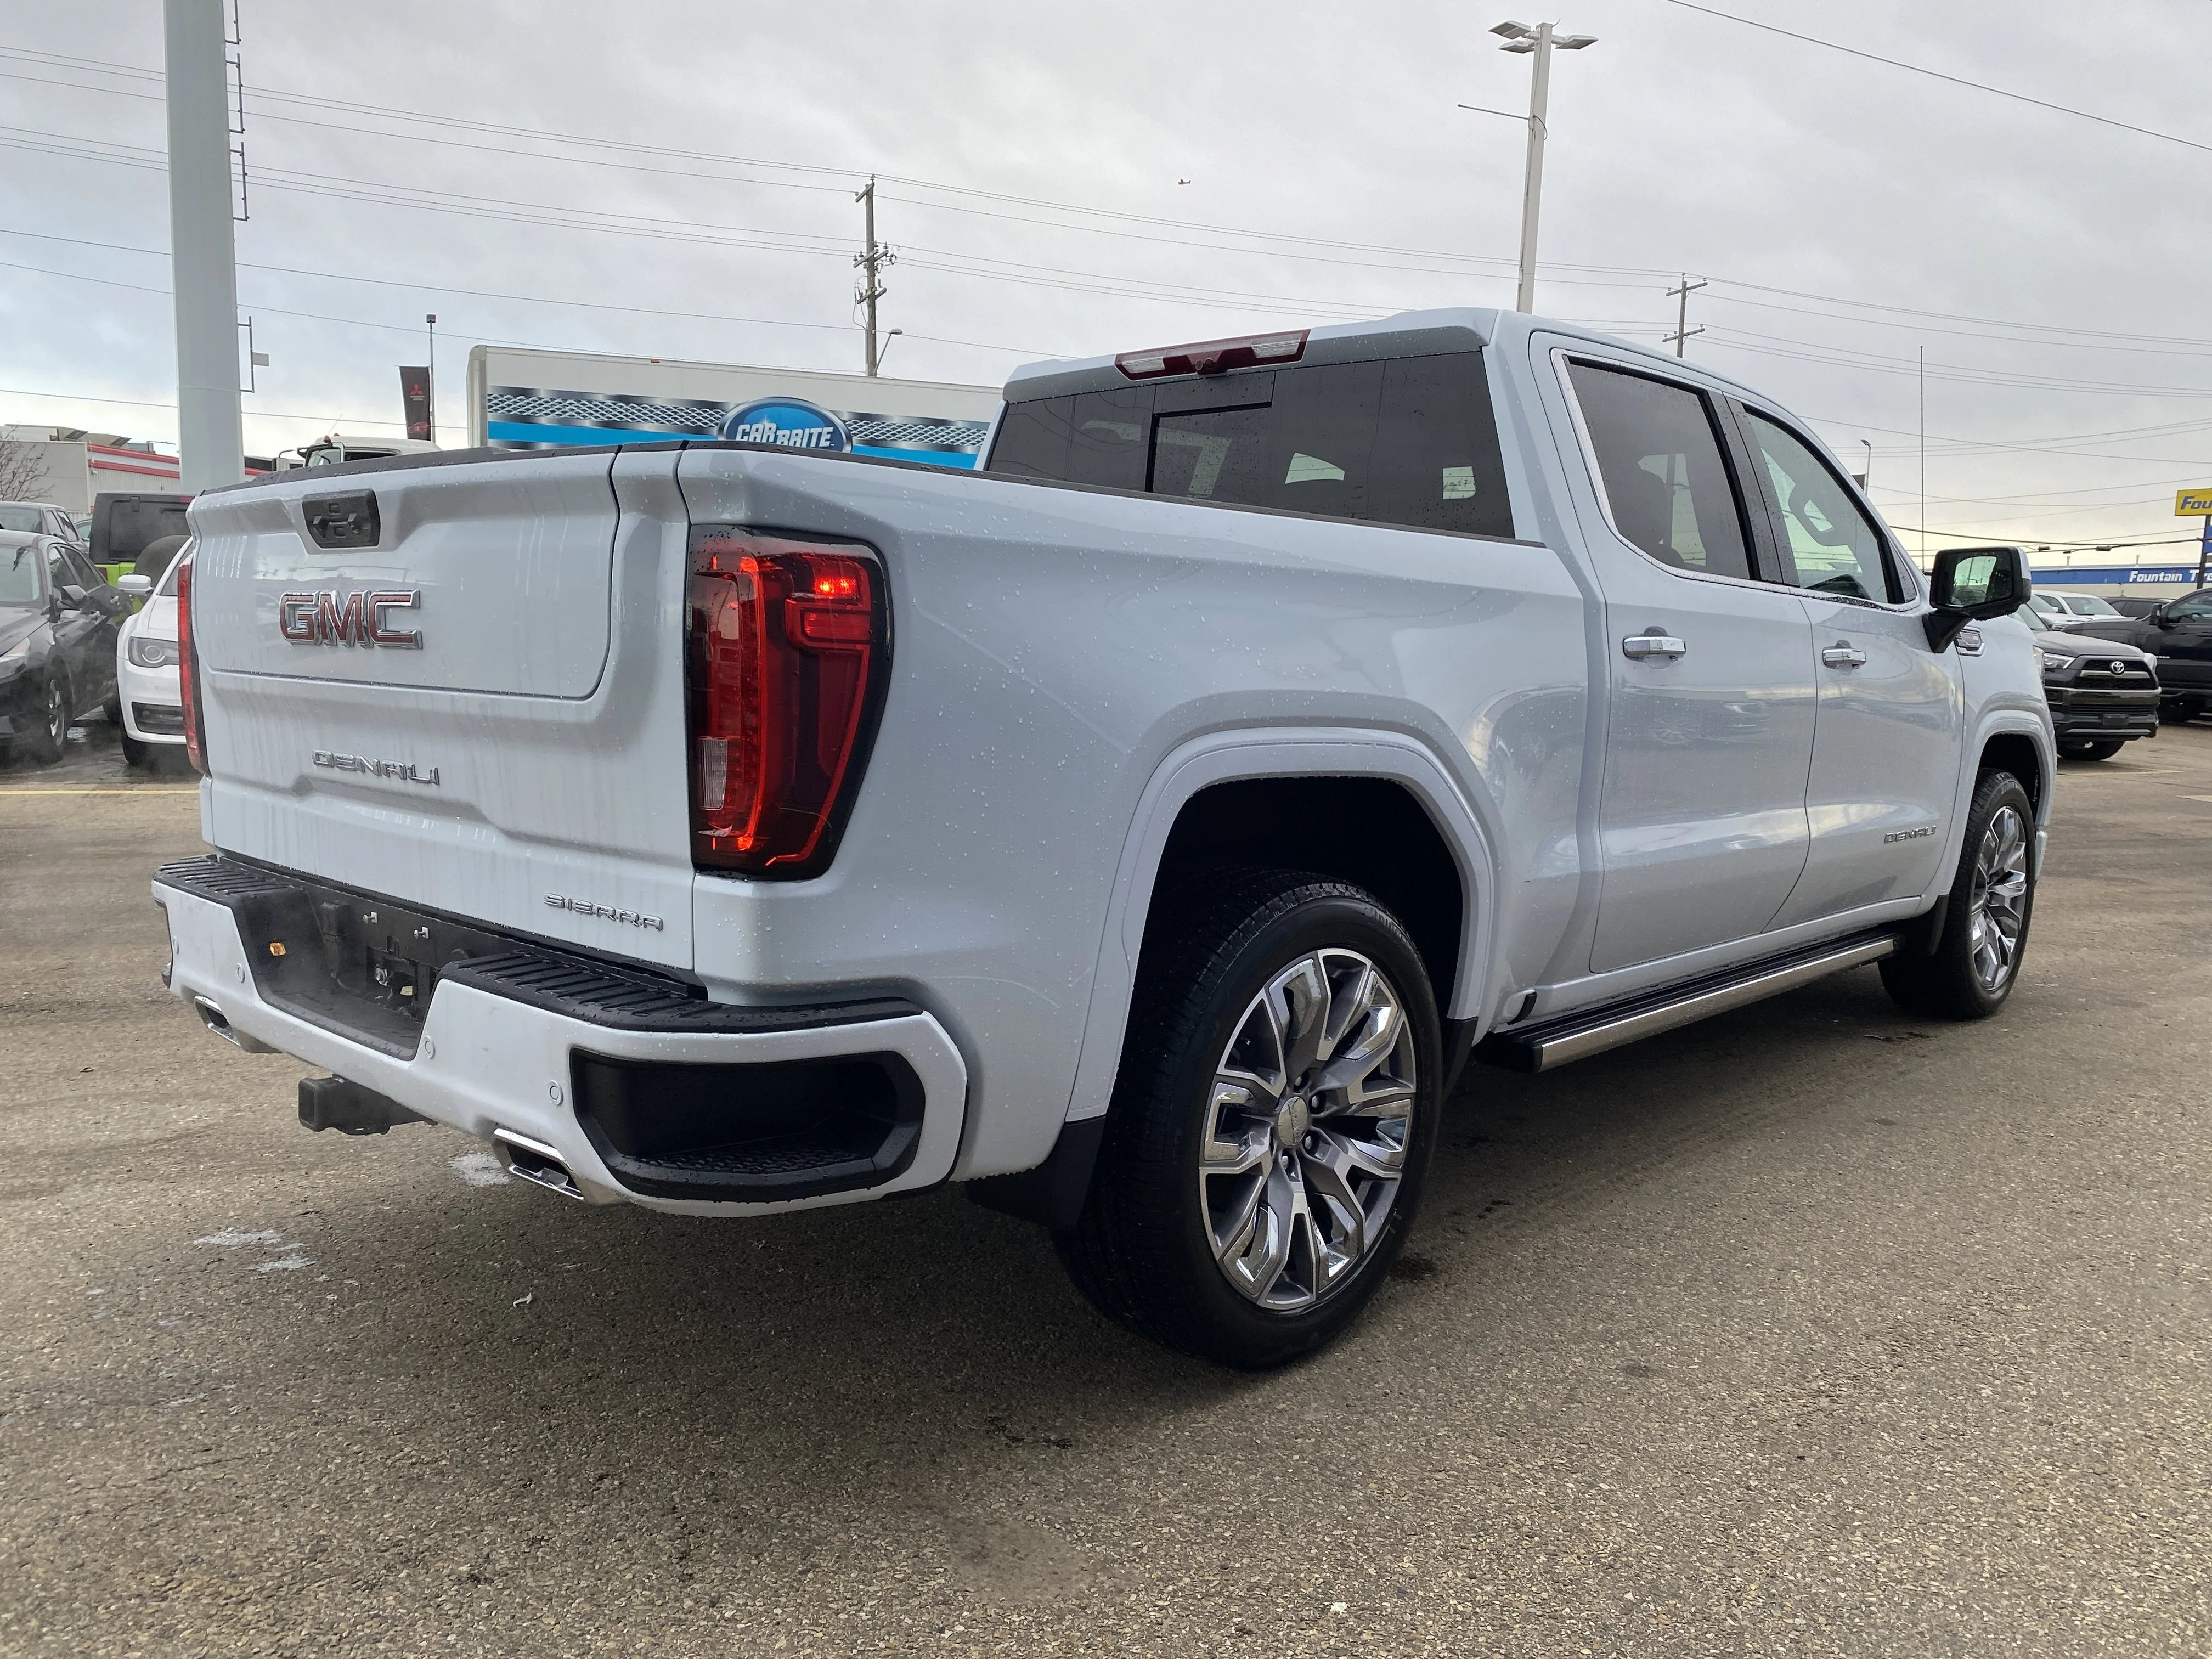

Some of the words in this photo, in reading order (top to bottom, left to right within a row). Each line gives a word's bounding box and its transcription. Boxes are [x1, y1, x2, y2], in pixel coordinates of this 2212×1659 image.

[735, 422, 777, 442] CAR
[776, 427, 833, 448] BRITE
[2129, 570, 2183, 583] Fountain
[280, 590, 423, 650] GMC
[312, 749, 440, 786] DENALI
[1883, 825, 1937, 844] DENALI
[544, 892, 663, 932] SIERRA
